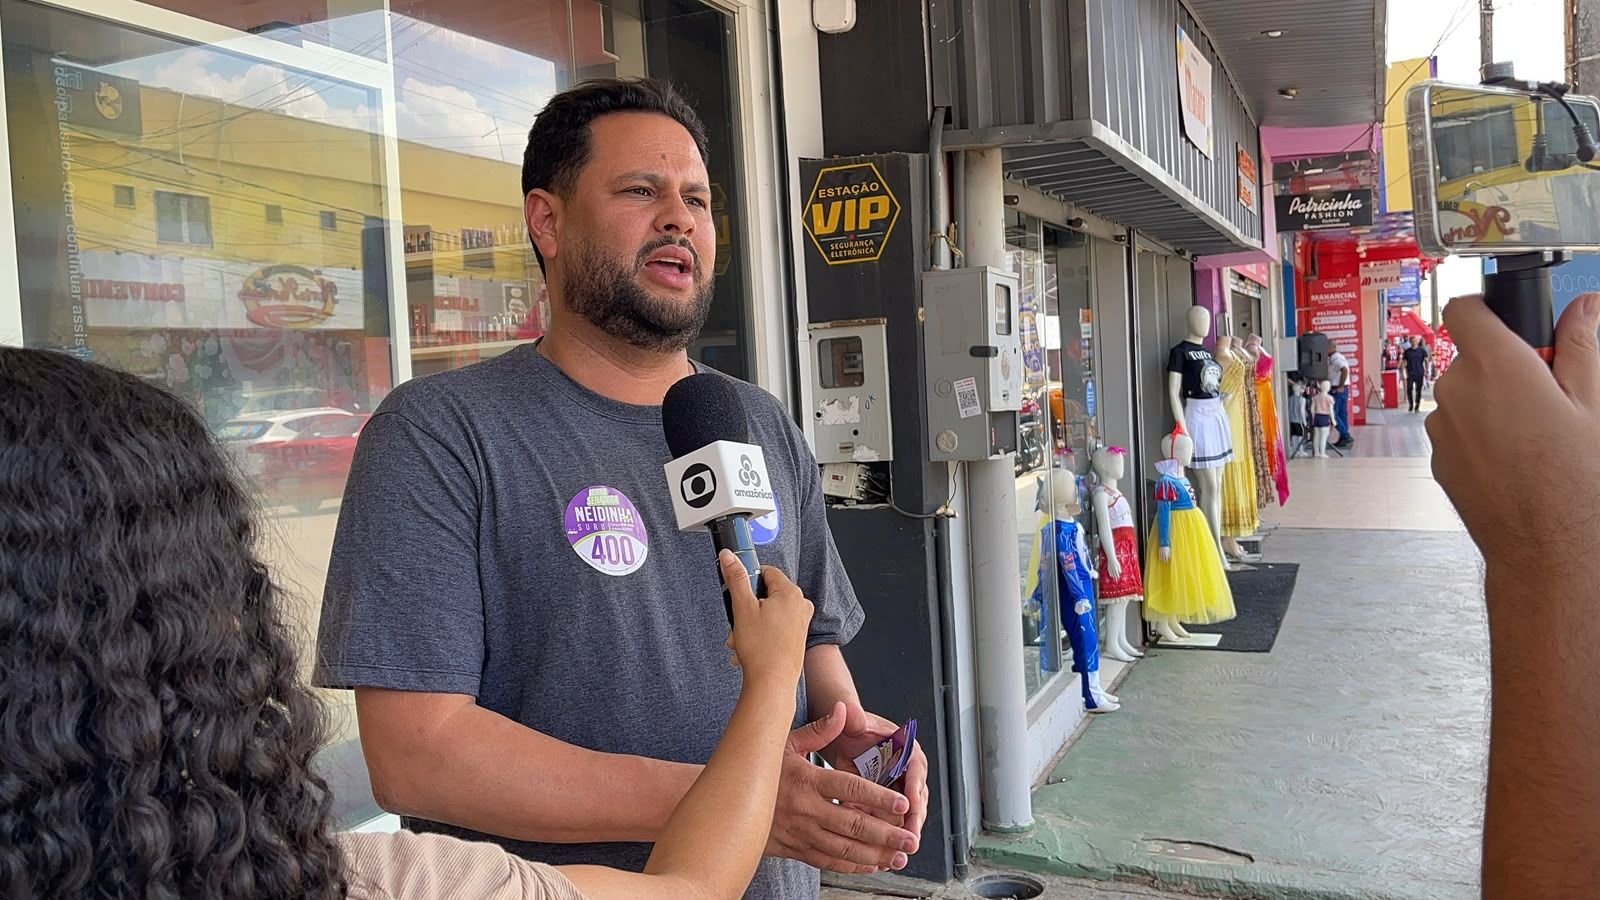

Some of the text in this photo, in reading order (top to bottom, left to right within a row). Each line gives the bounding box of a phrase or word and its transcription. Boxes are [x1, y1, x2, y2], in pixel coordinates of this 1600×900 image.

[818, 182, 879, 198] ESTAÇÃO
[62, 181, 75, 219] Quer
[1289, 193, 1362, 215] Patricinha
[812, 195, 890, 235] VIP
[1304, 210, 1353, 220] FASHION
[830, 239, 875, 250] SEGURANÇA
[830, 247, 875, 258] ELETRÔNICA
[67, 223, 82, 301] continuar
[1323, 280, 1345, 289] Claro
[1311, 291, 1357, 302] MANANCIAL
[734, 489, 773, 499] amazônica
[574, 506, 634, 523] NEIDINHA
[591, 535, 635, 566] 400
